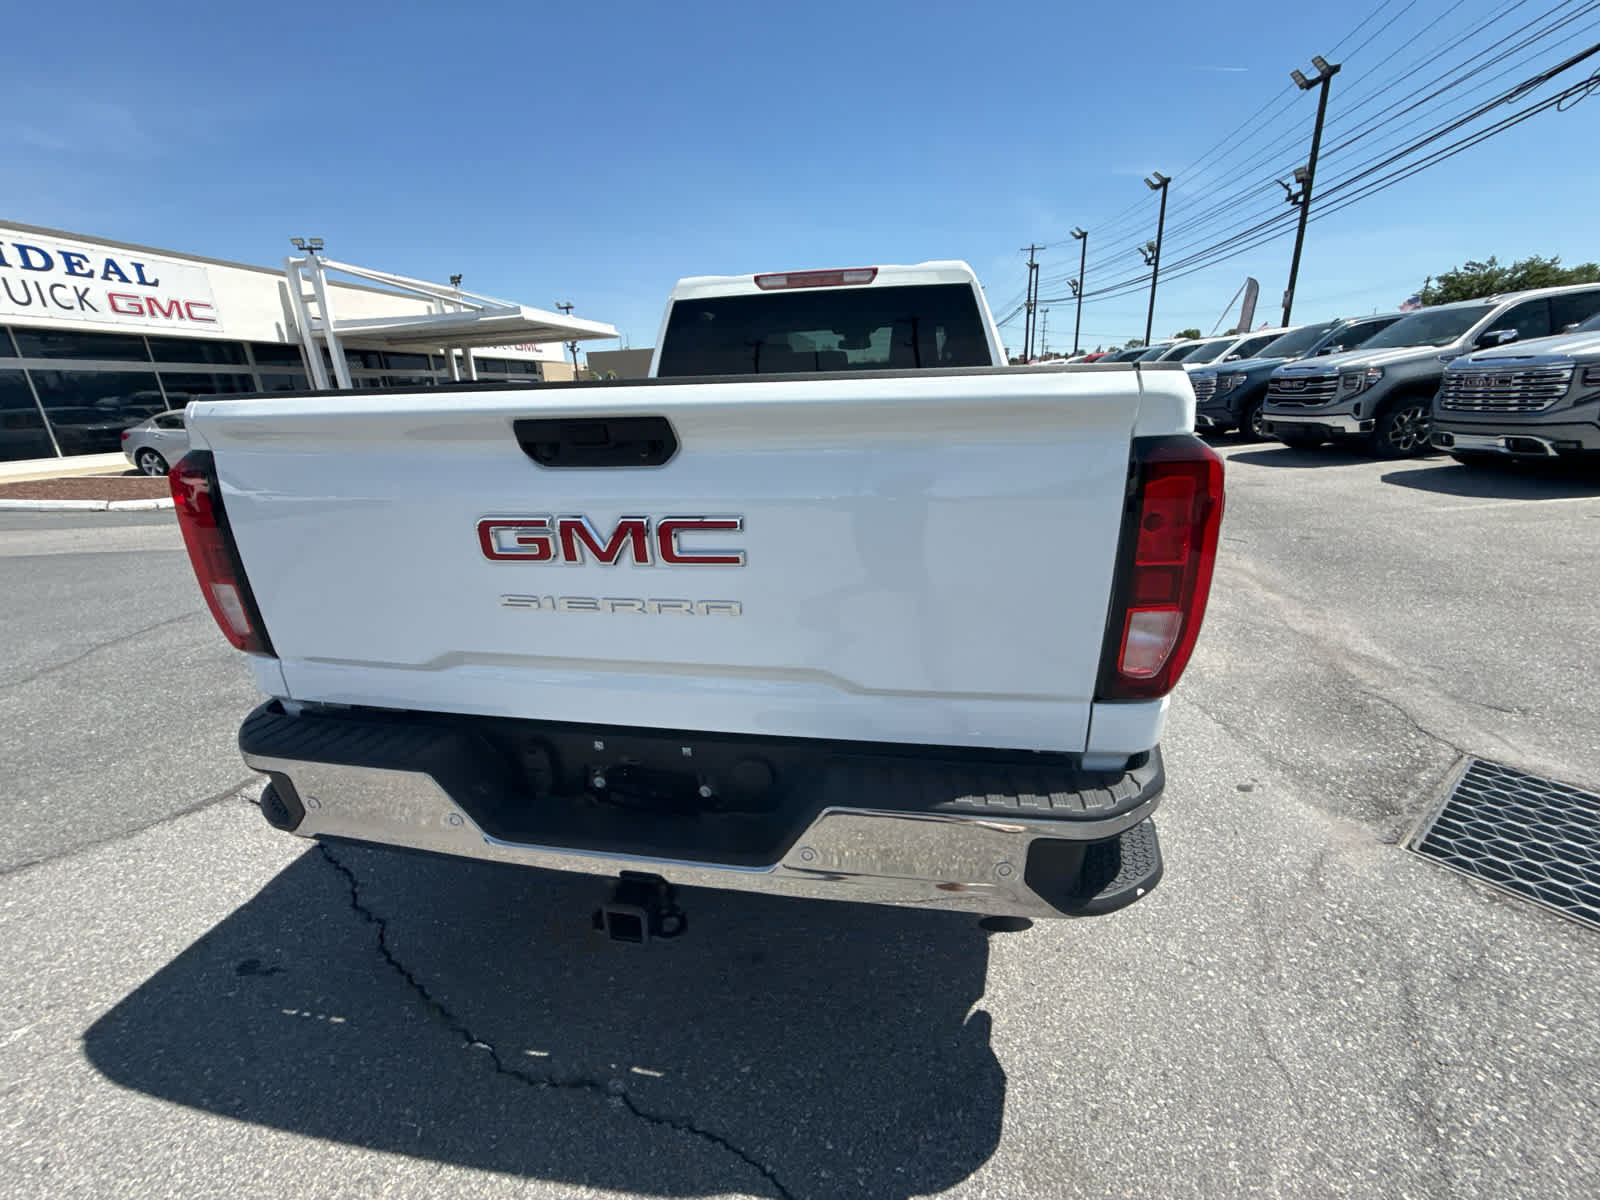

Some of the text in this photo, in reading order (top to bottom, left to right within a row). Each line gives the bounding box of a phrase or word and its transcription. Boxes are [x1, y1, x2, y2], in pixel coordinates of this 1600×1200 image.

[107, 292, 217, 322] GMC
[477, 514, 746, 567] GMC
[499, 594, 743, 616] SIERRA
